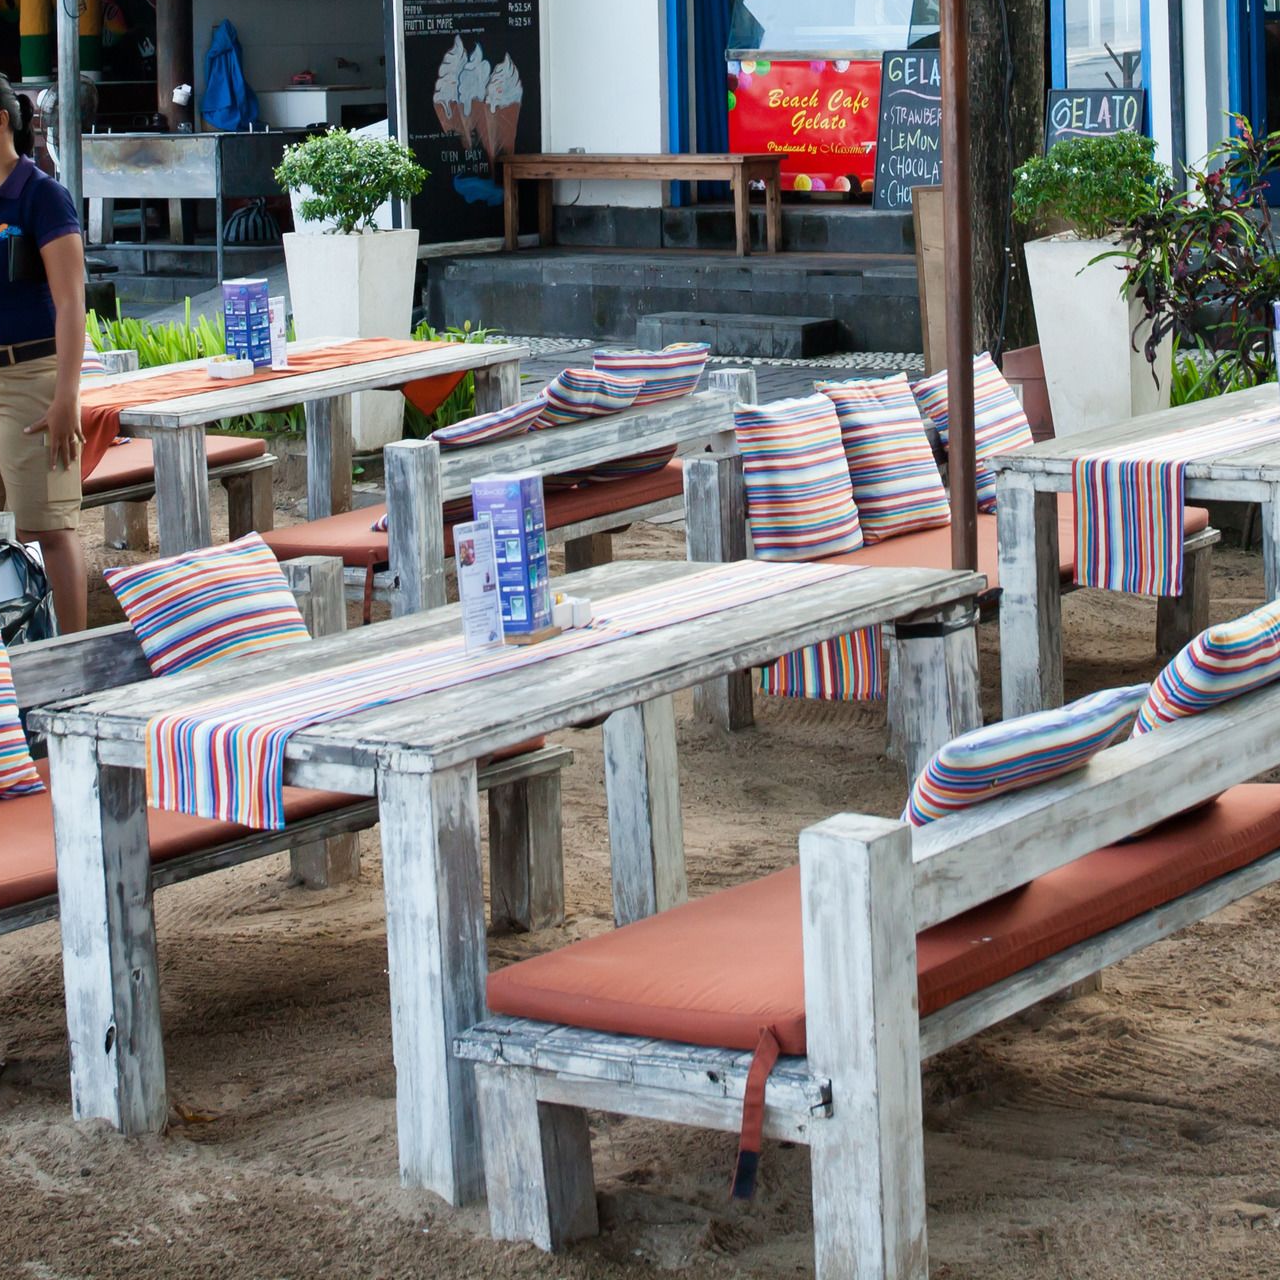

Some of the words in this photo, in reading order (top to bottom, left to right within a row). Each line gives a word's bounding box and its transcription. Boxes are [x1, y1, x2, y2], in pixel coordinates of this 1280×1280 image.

[768, 89, 819, 108] Beach
[827, 89, 870, 114] Cafe
[1051, 96, 1138, 129] GELATO
[791, 111, 847, 135] Gelato
[767, 142, 805, 152] Produced
[808, 143, 817, 155] by
[890, 129, 938, 152] LEMON
